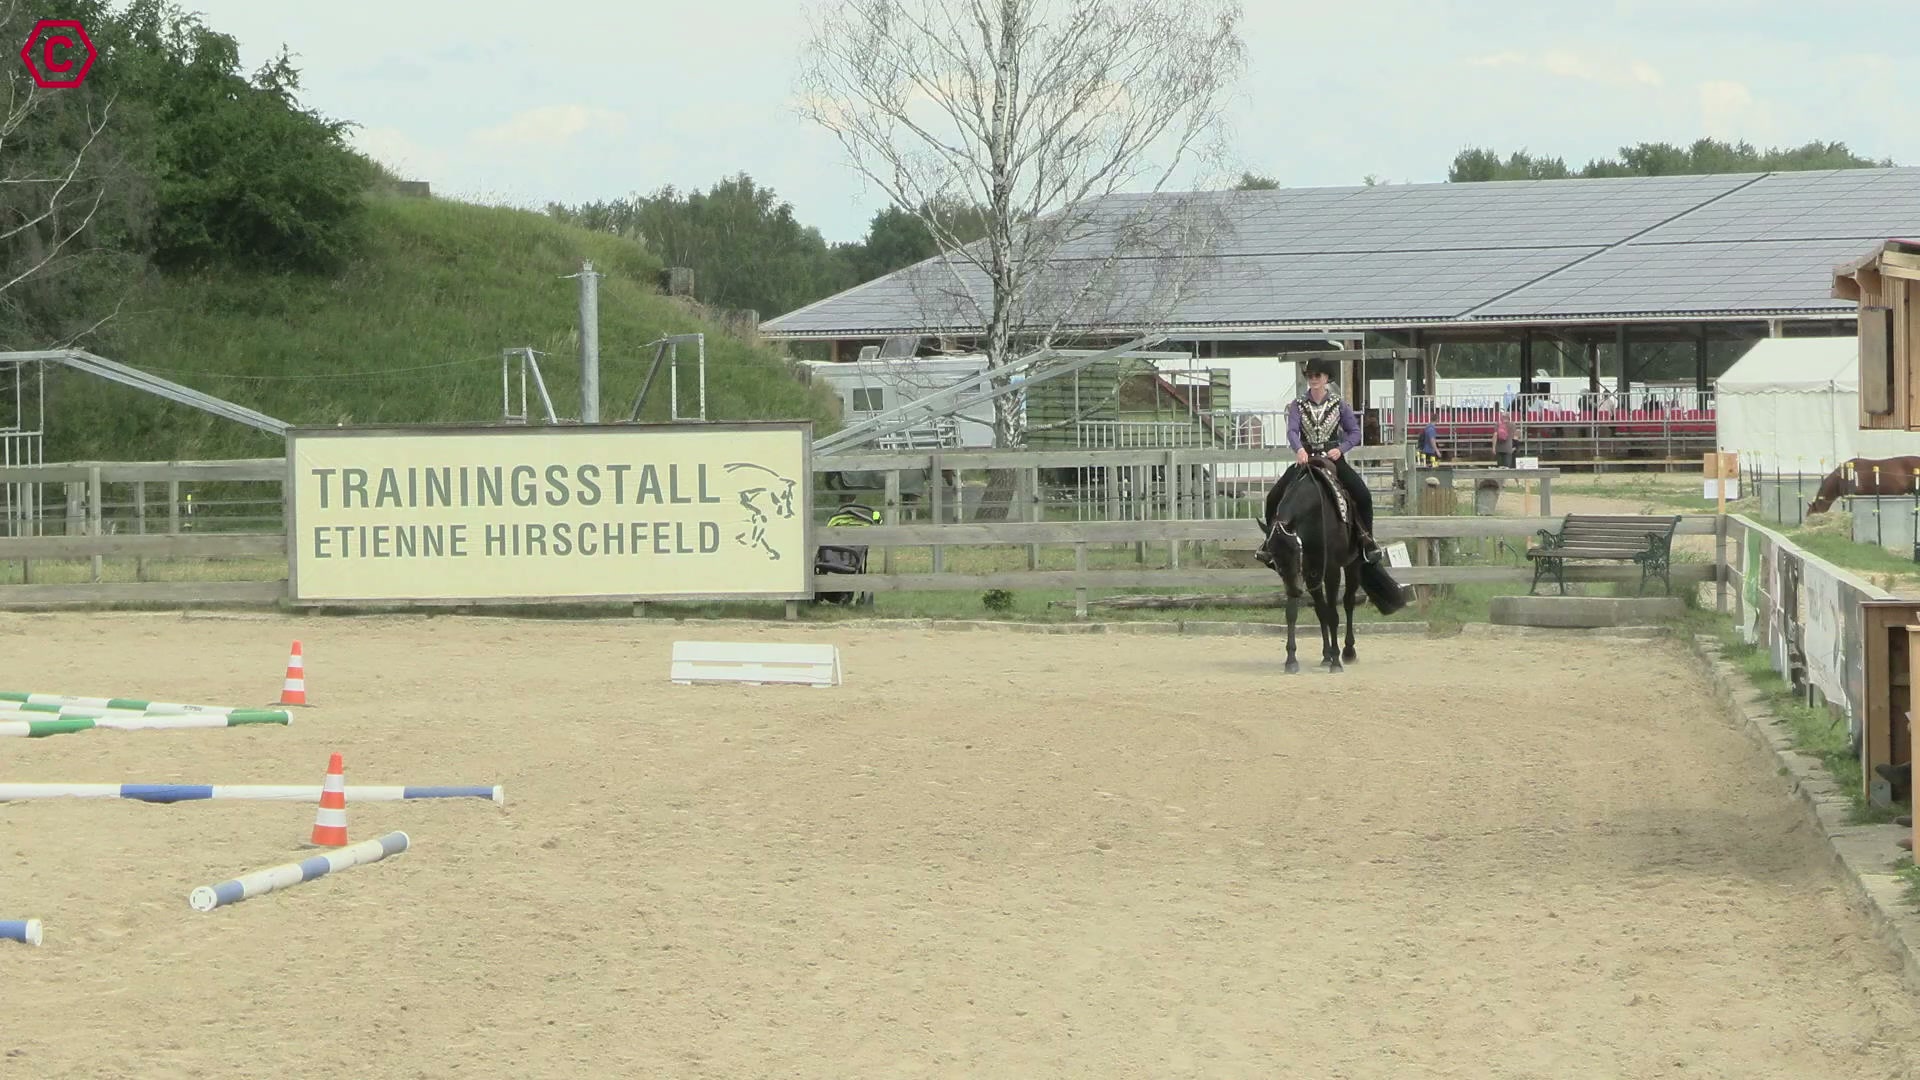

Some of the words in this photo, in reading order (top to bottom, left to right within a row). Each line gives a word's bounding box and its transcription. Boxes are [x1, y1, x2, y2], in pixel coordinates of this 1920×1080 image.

[311, 463, 721, 508] TRAININGSSTALL
[313, 524, 468, 558] ETIENNE
[485, 521, 720, 556] HIRSCHFELD
